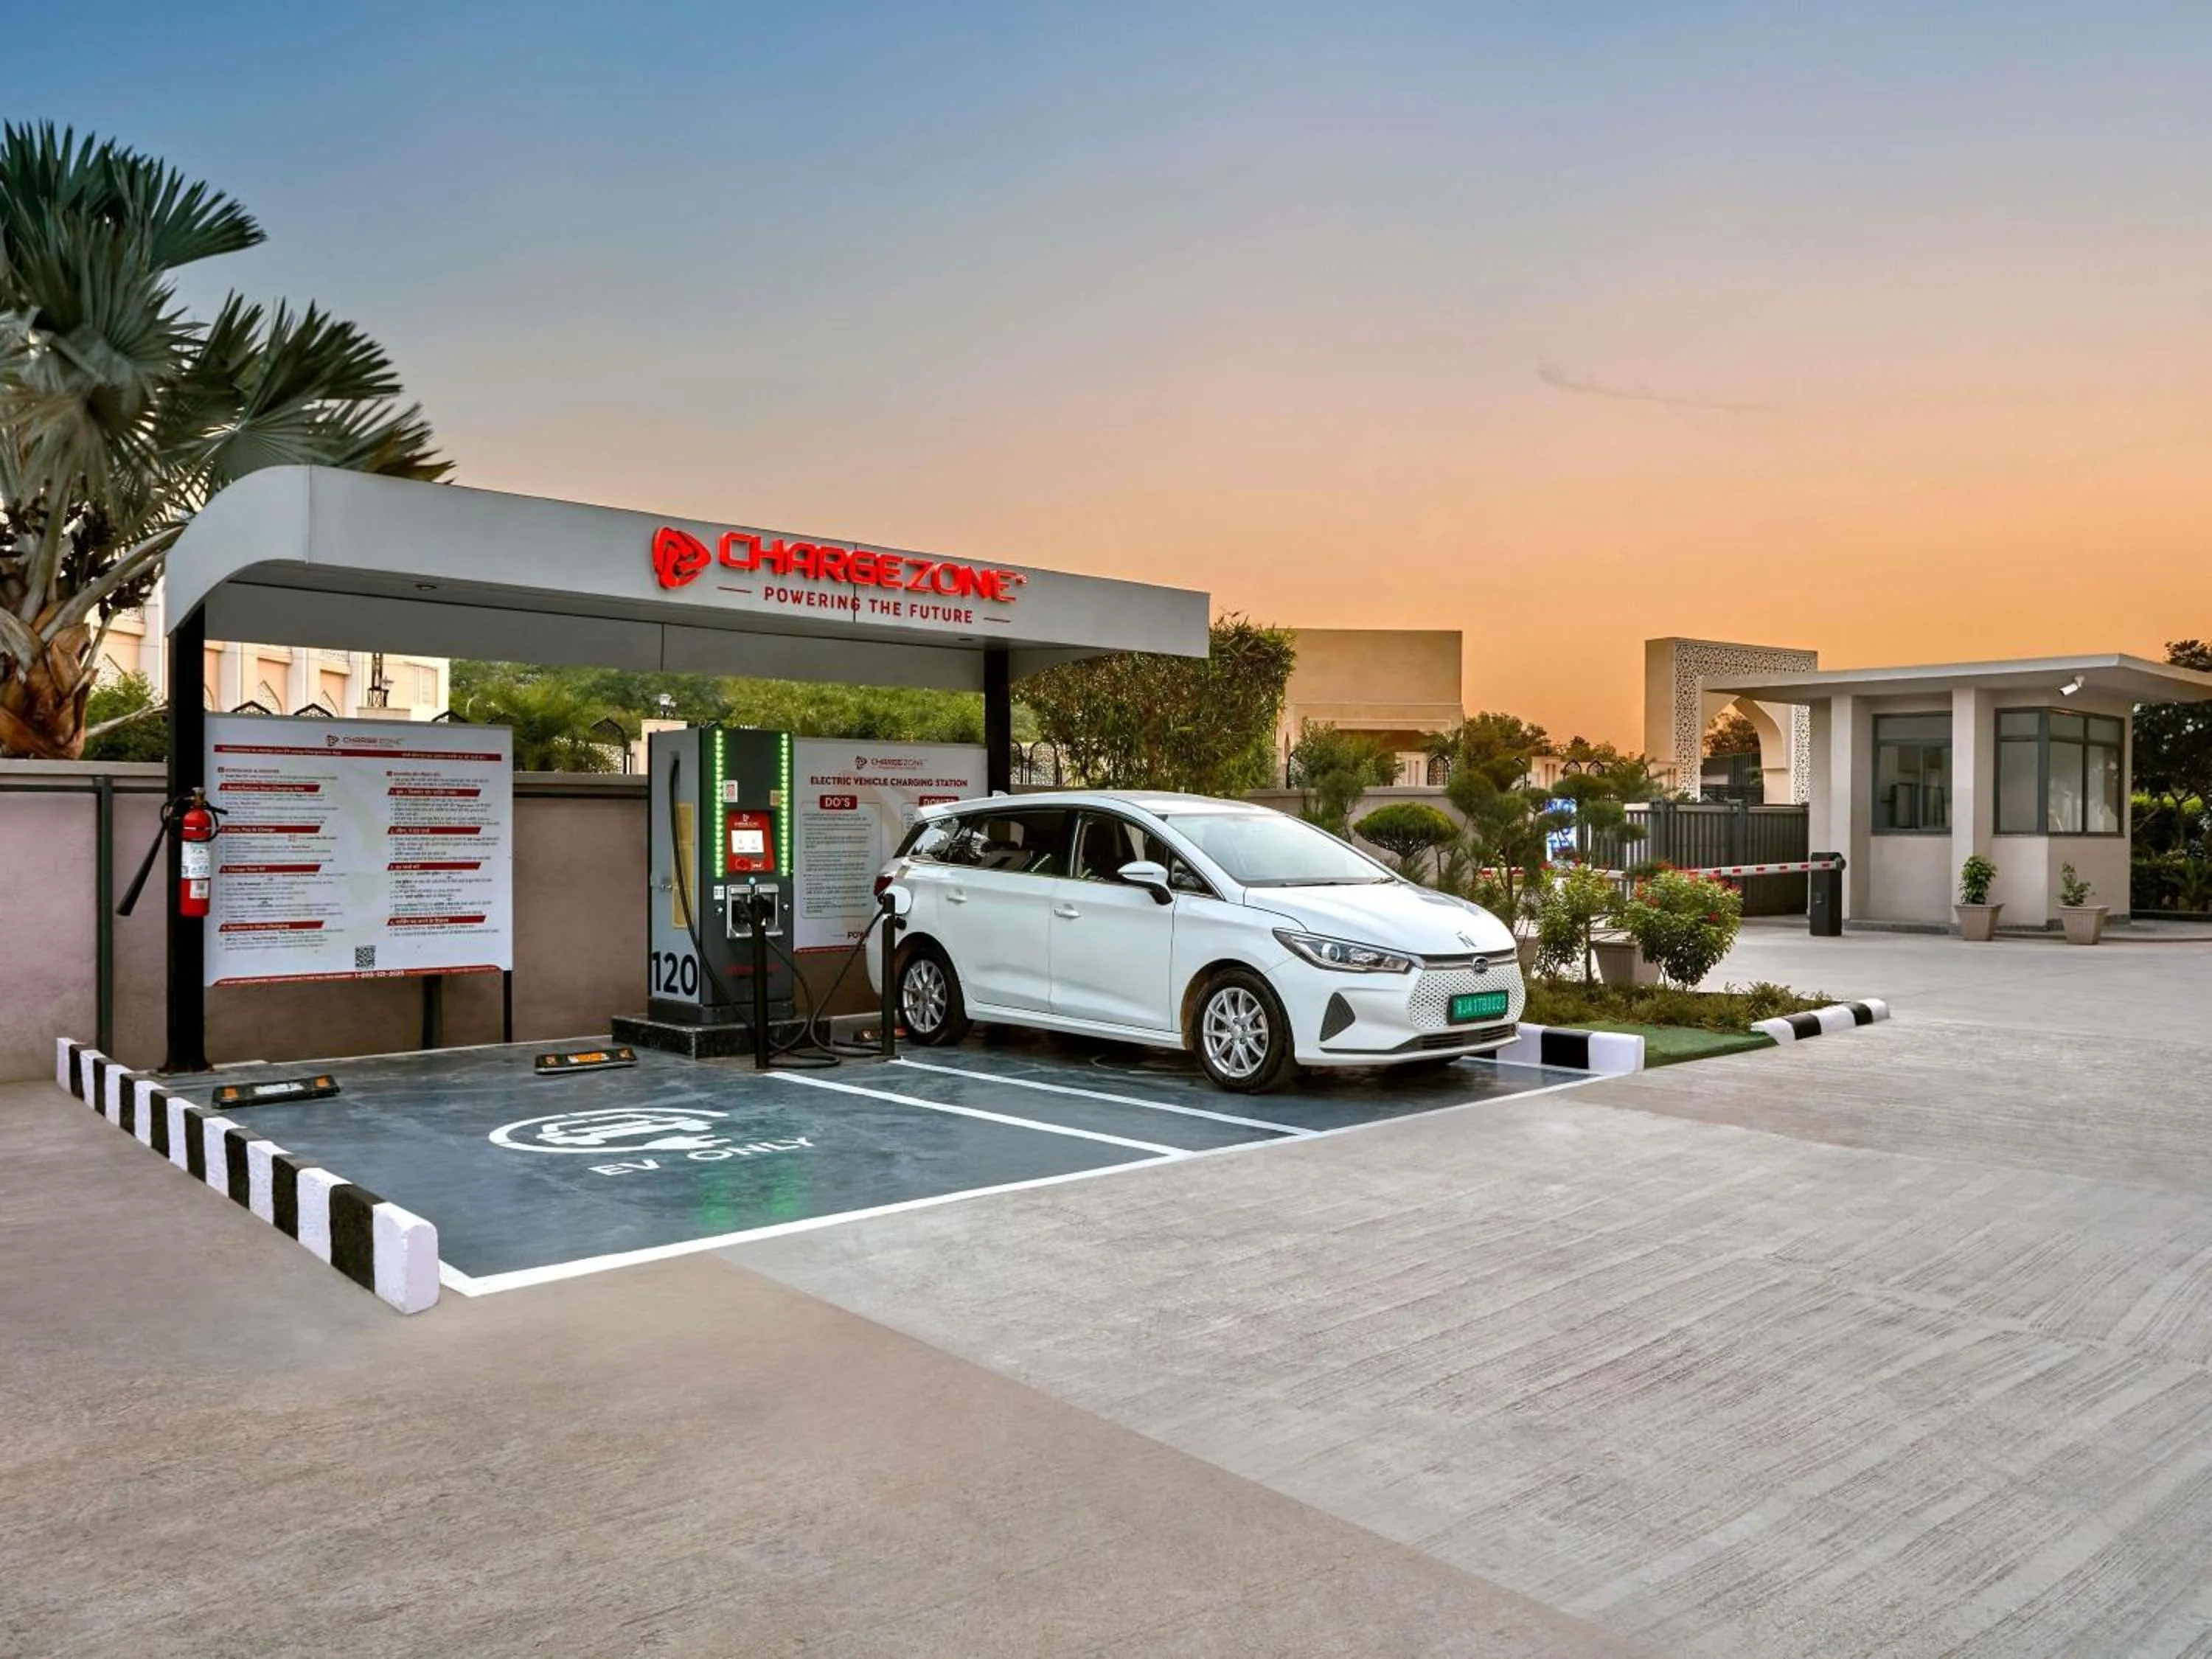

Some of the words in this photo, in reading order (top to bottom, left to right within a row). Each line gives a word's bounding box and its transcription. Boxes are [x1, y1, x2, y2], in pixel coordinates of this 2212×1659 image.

[764, 586, 860, 611] POWERING
[869, 599, 902, 616] THE
[909, 604, 973, 624] FUTURE
[811, 776, 852, 785] ELECTRIC
[854, 777, 888, 786] VEHICLE
[890, 778, 933, 787] CHARGING
[935, 779, 968, 787] STATION
[825, 797, 850, 807] DO'S
[652, 951, 698, 996] 120
[588, 1159, 660, 1176] EV
[687, 1137, 814, 1161] ONLY
